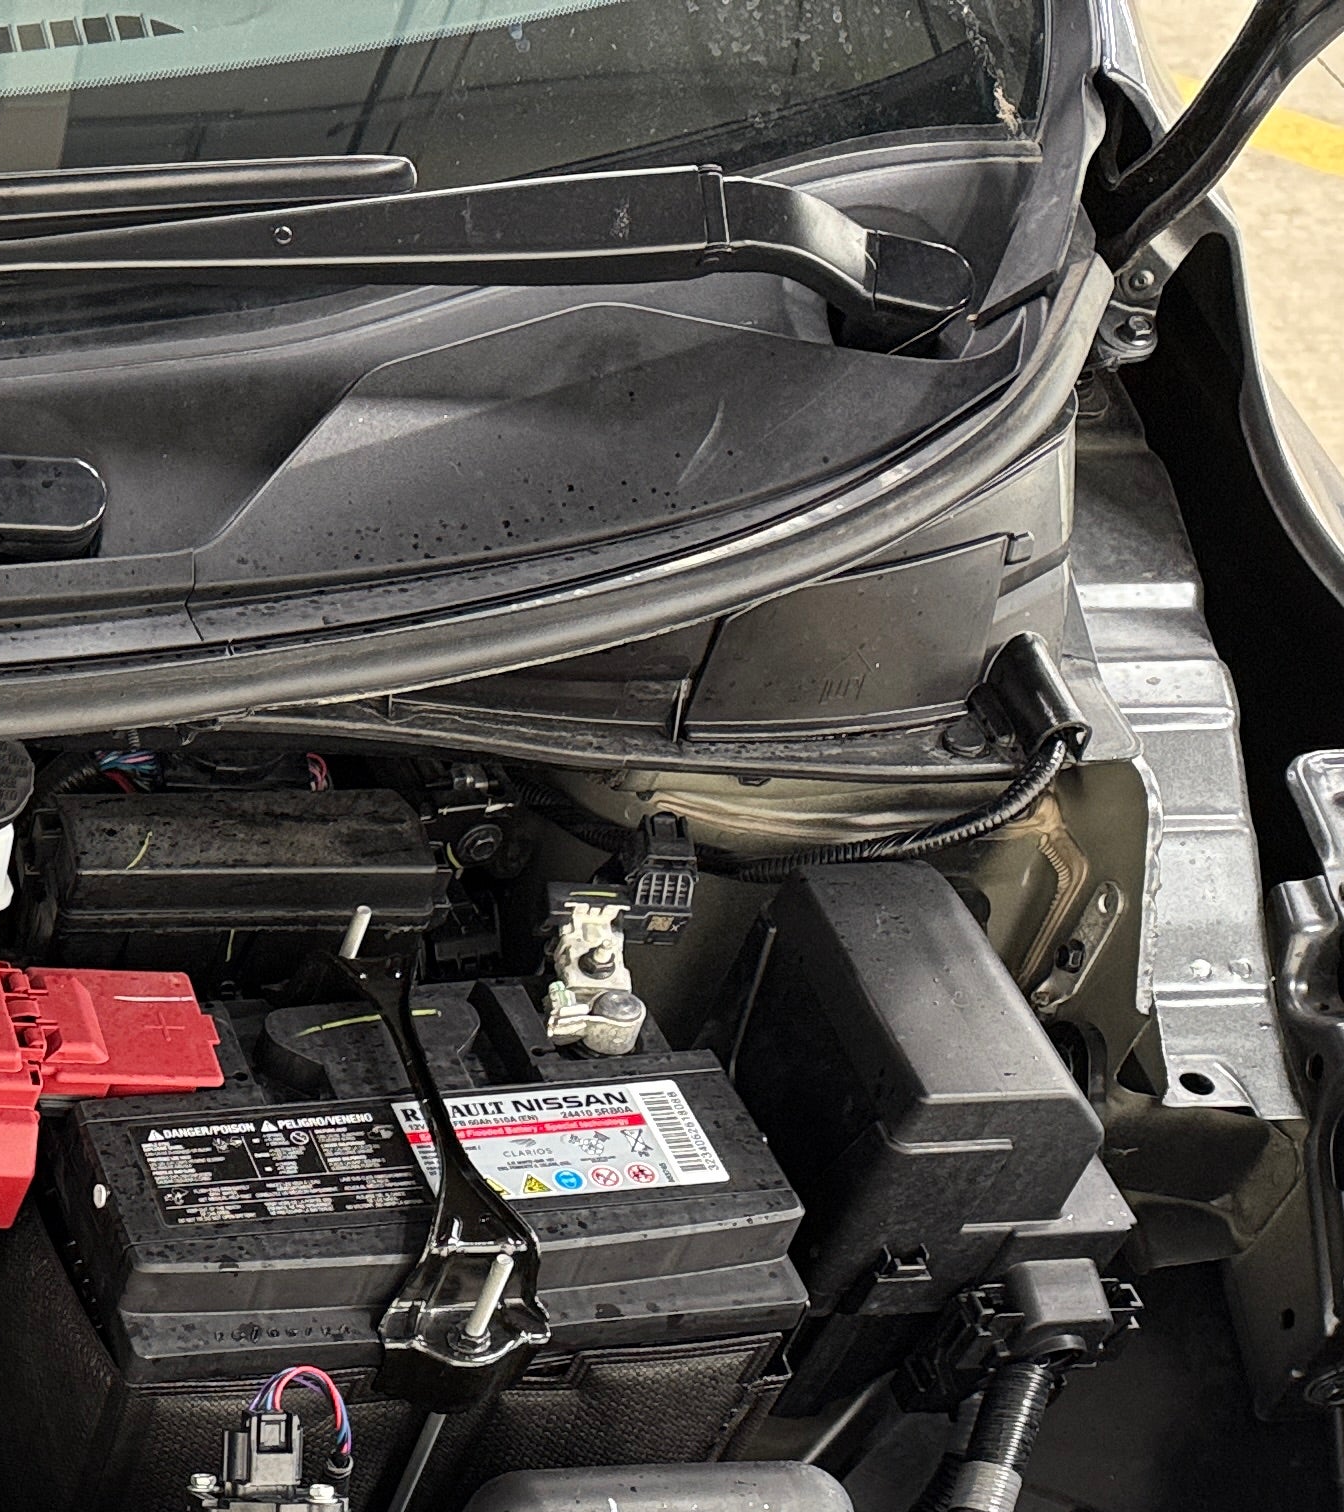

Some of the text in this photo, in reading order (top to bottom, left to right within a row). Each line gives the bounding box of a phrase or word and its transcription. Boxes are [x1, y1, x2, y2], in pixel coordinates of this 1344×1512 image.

[401, 1090, 628, 1122] RAULT NISSAN
[278, 1112, 374, 1130] PELIGRO/VENENO
[163, 1122, 255, 1139] DANGER/POISON
[503, 1146, 553, 1158] CLARIOS
